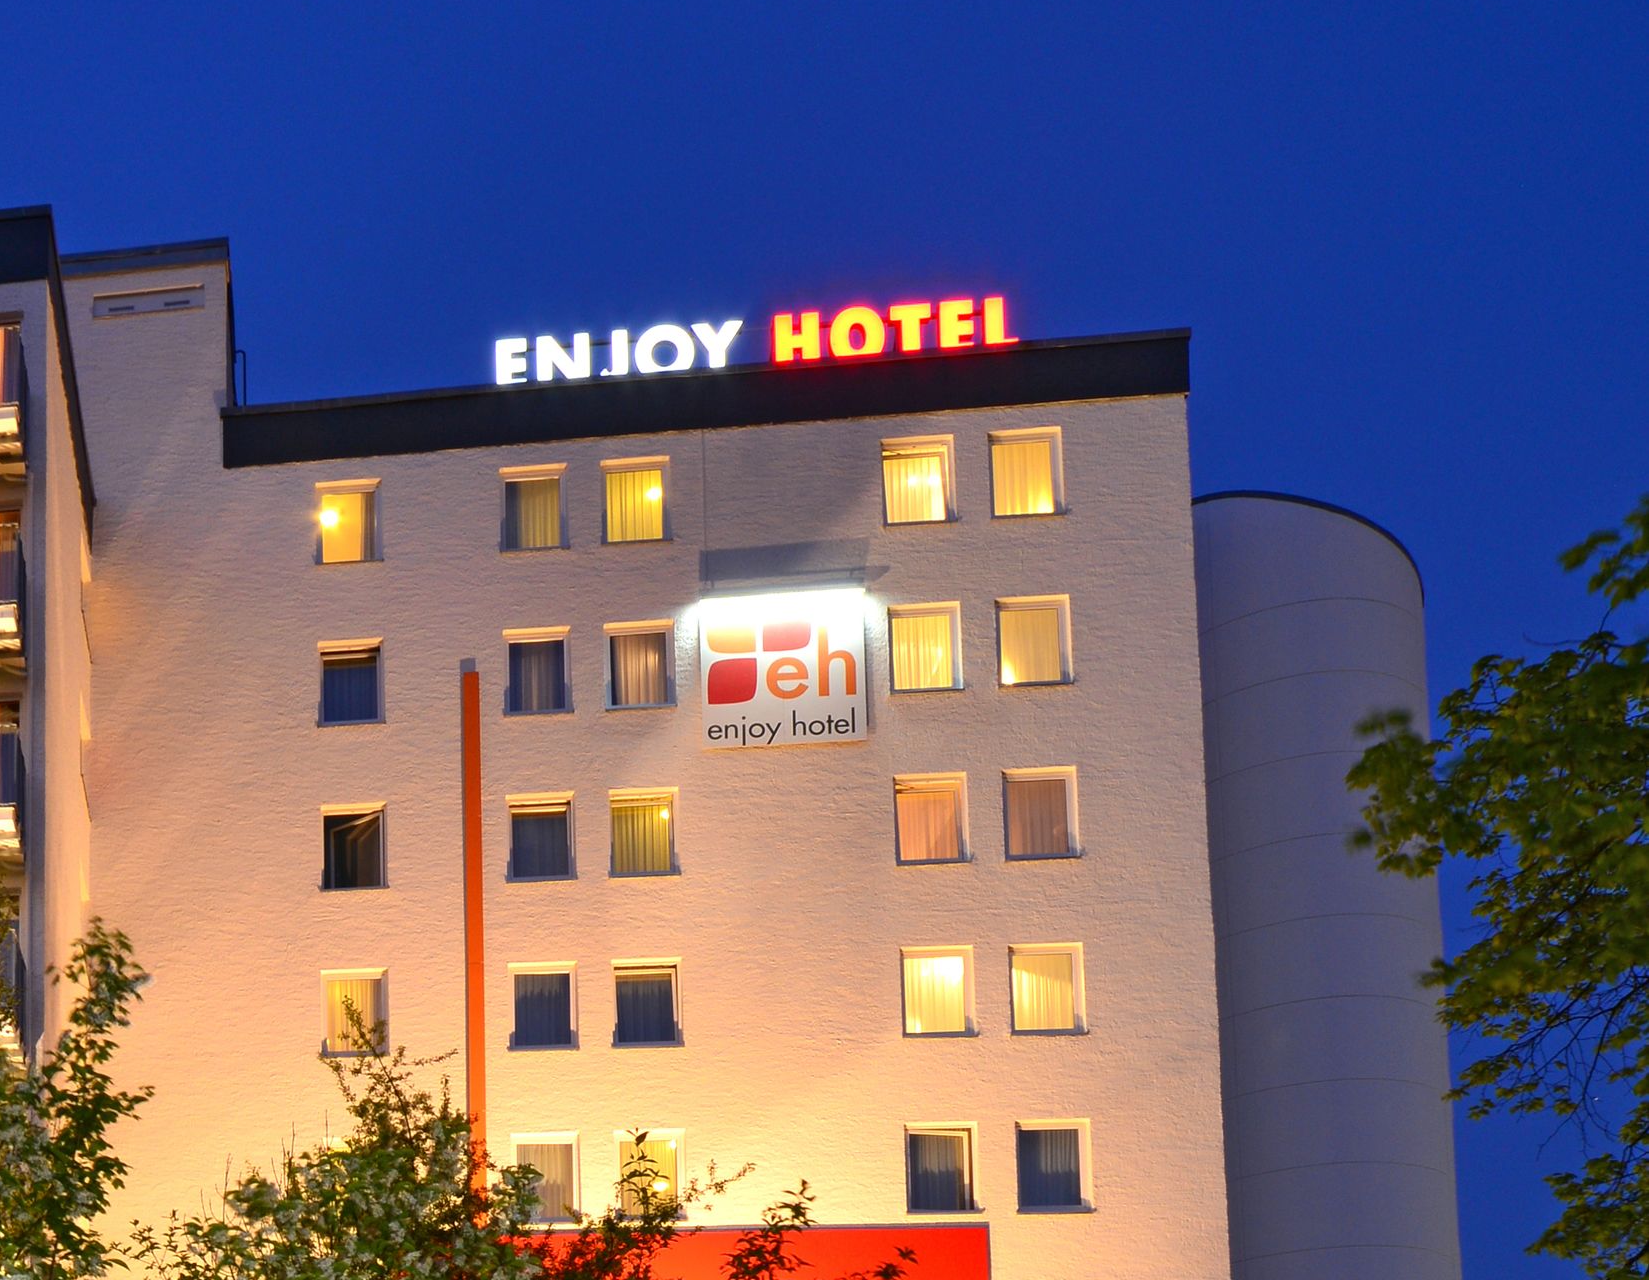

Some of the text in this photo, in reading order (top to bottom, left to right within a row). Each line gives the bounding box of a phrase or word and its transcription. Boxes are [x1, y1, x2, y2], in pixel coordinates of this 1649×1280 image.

[495, 295, 1020, 385] ENJOY HOTEL
[766, 625, 857, 700] eh
[707, 707, 856, 746] enjoy hotel
